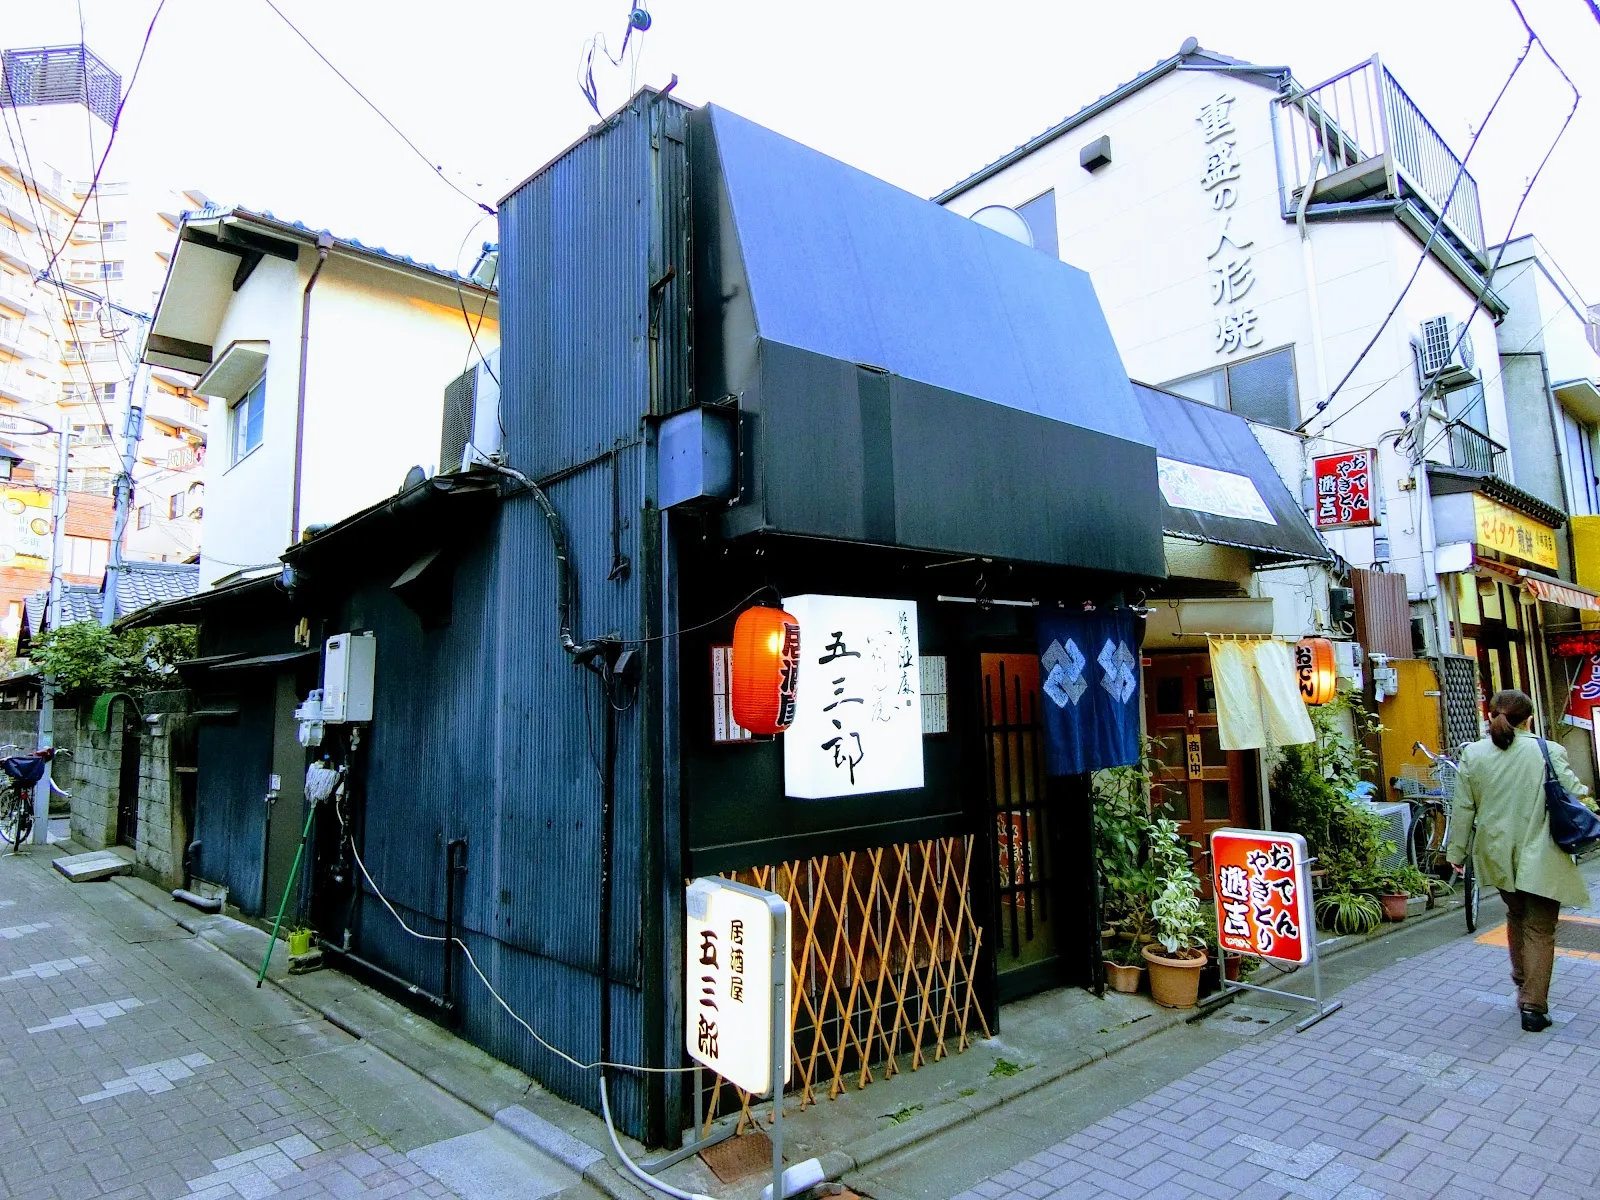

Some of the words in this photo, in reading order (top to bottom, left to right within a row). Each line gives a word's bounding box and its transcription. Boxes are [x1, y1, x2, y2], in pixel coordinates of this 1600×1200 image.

[1195, 93, 1263, 354] 重盛の人形焼
[1318, 475, 1336, 517] 遊吉
[1336, 461, 1352, 521] やきとり
[1295, 646, 1314, 697] おでん
[818, 631, 864, 786] 五三郎
[1188, 740, 1201, 776] 商い中
[1220, 865, 1251, 938] 遊吉
[1247, 850, 1274, 952] やきとり
[730, 919, 744, 1004] 居酒屋
